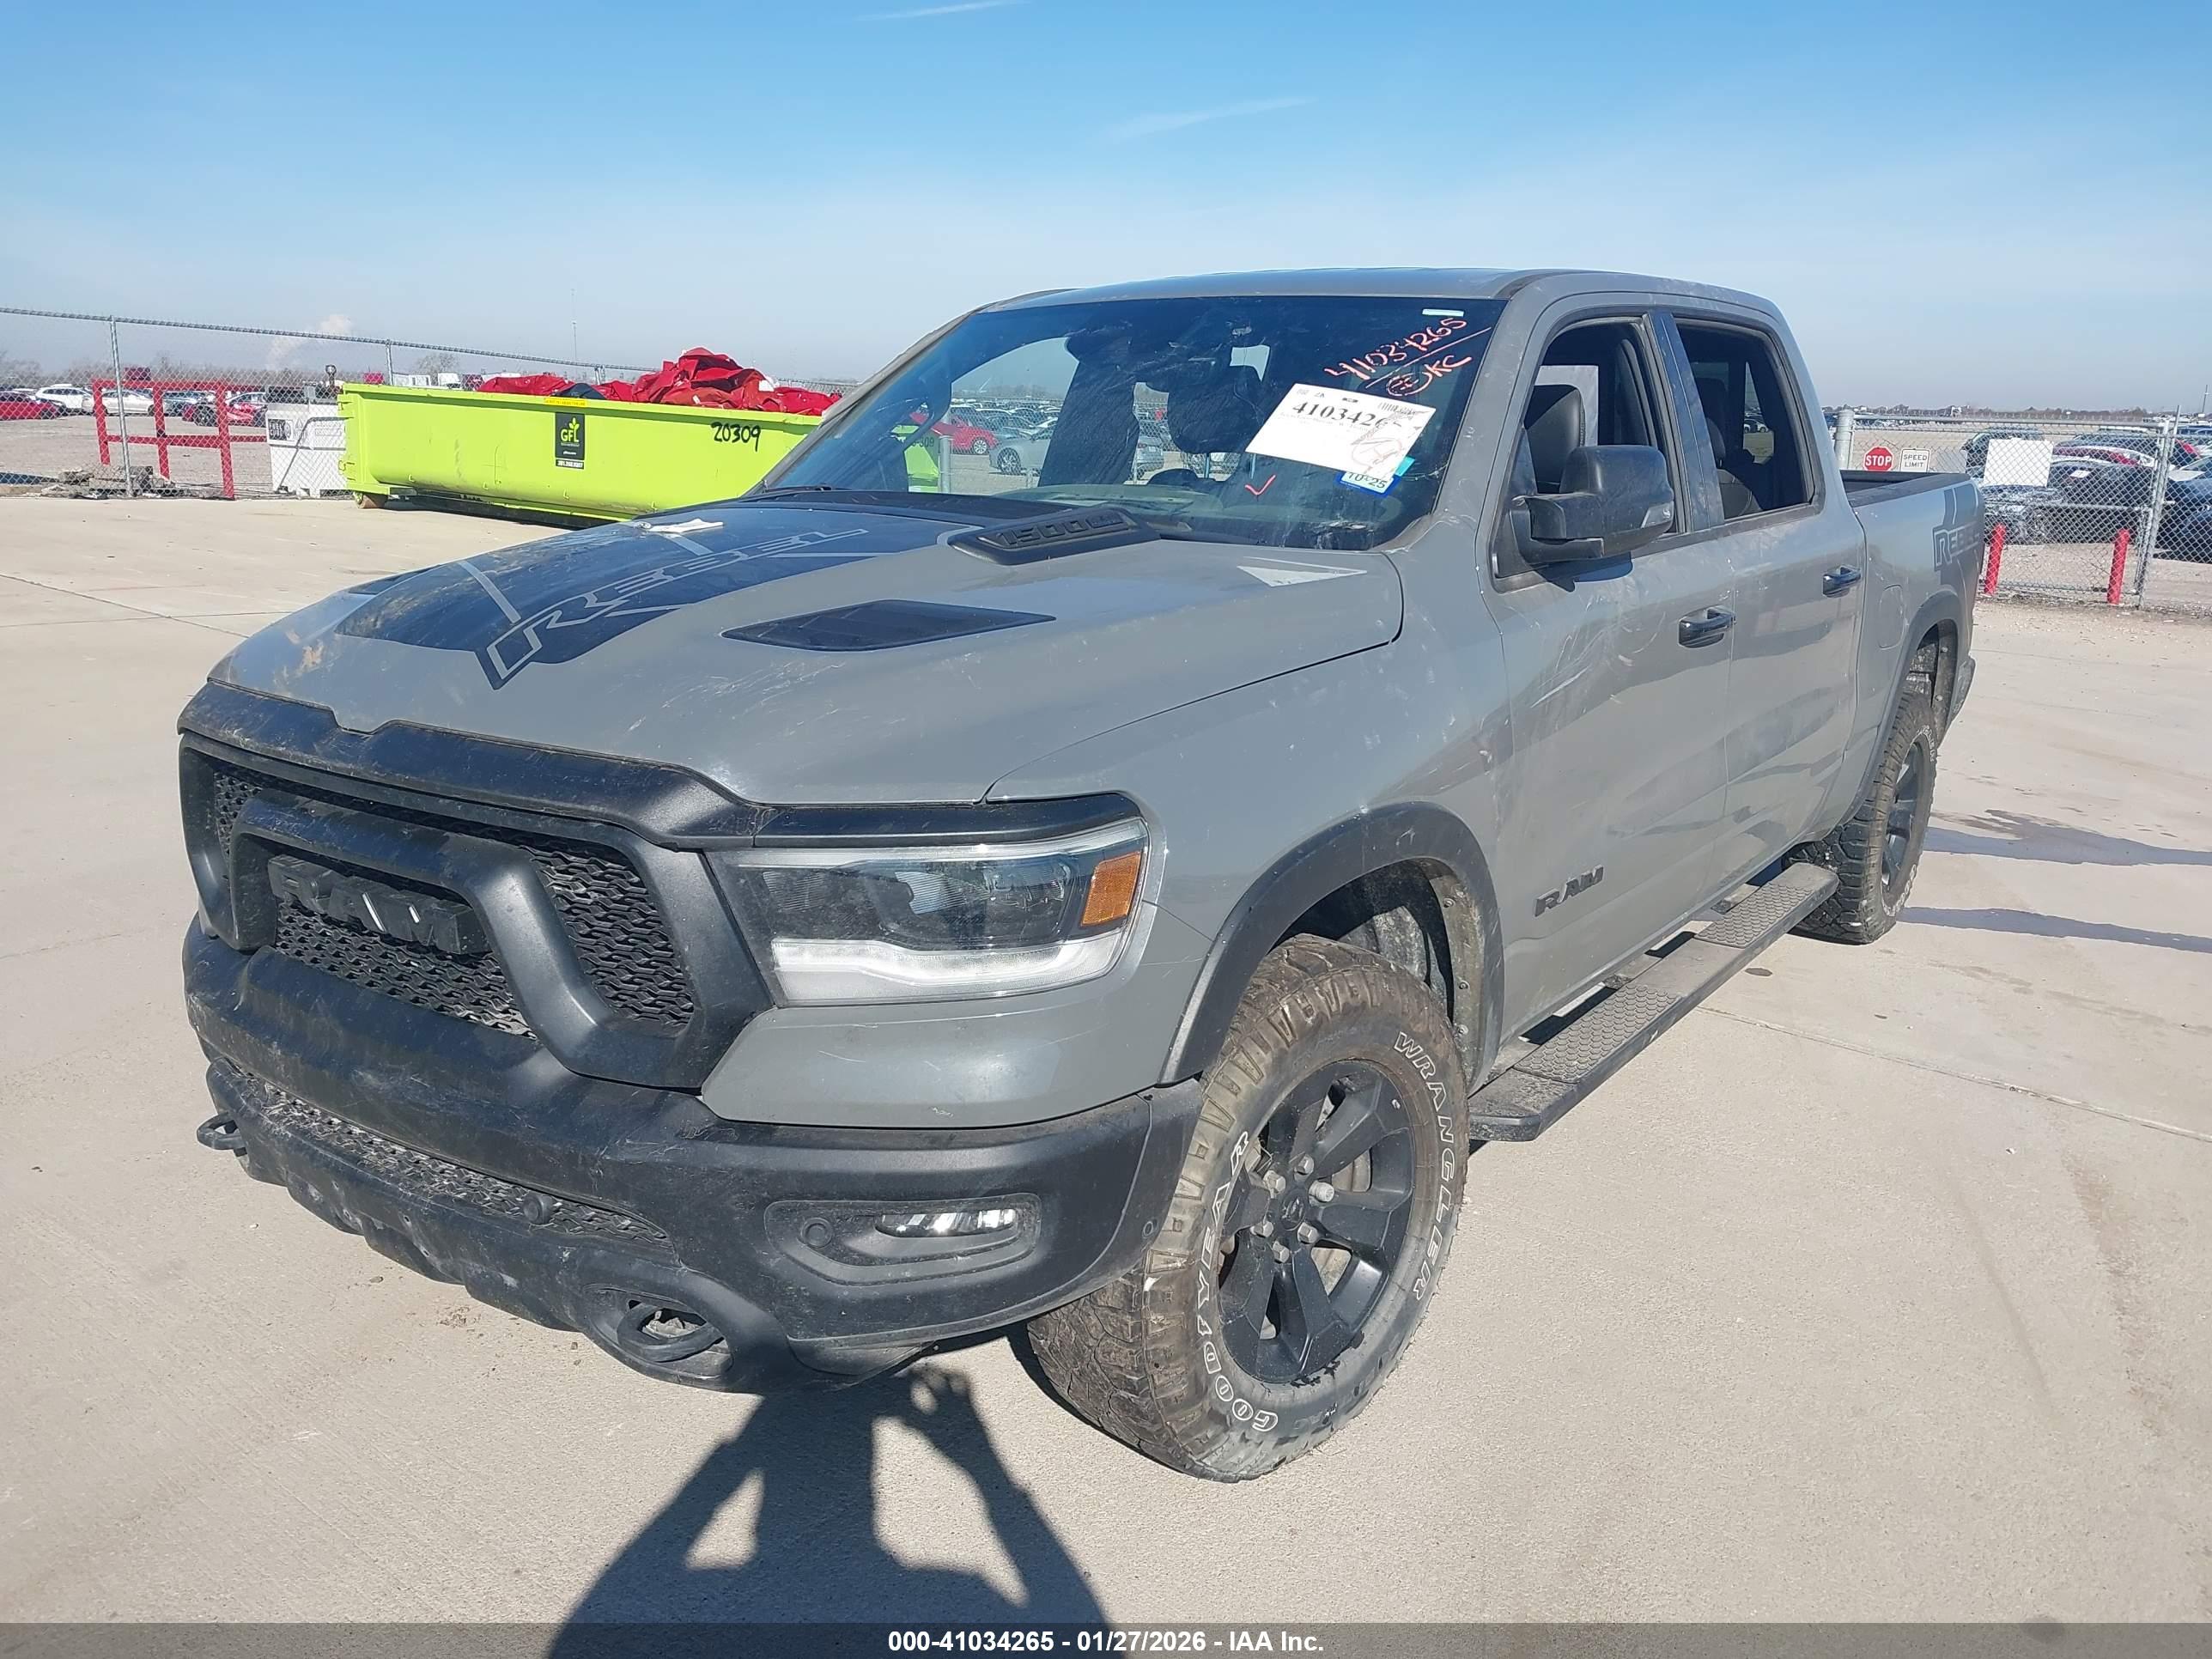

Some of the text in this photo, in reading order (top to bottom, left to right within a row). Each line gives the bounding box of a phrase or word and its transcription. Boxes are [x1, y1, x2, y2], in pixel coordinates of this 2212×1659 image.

[1323, 317, 1468, 380] 41034265
[1291, 401, 1403, 428] 4103426
[560, 428, 580, 443] GFL
[710, 421, 762, 452] 20309
[1865, 454, 1893, 466] STOP
[1368, 477, 1389, 489] 25
[996, 519, 1089, 545] 1500
[485, 527, 869, 682] REBEL
[1534, 864, 1604, 918] RAM
[1395, 1032, 1455, 1301] WRANGLER
[1196, 1131, 1279, 1432] GOODYEAR
